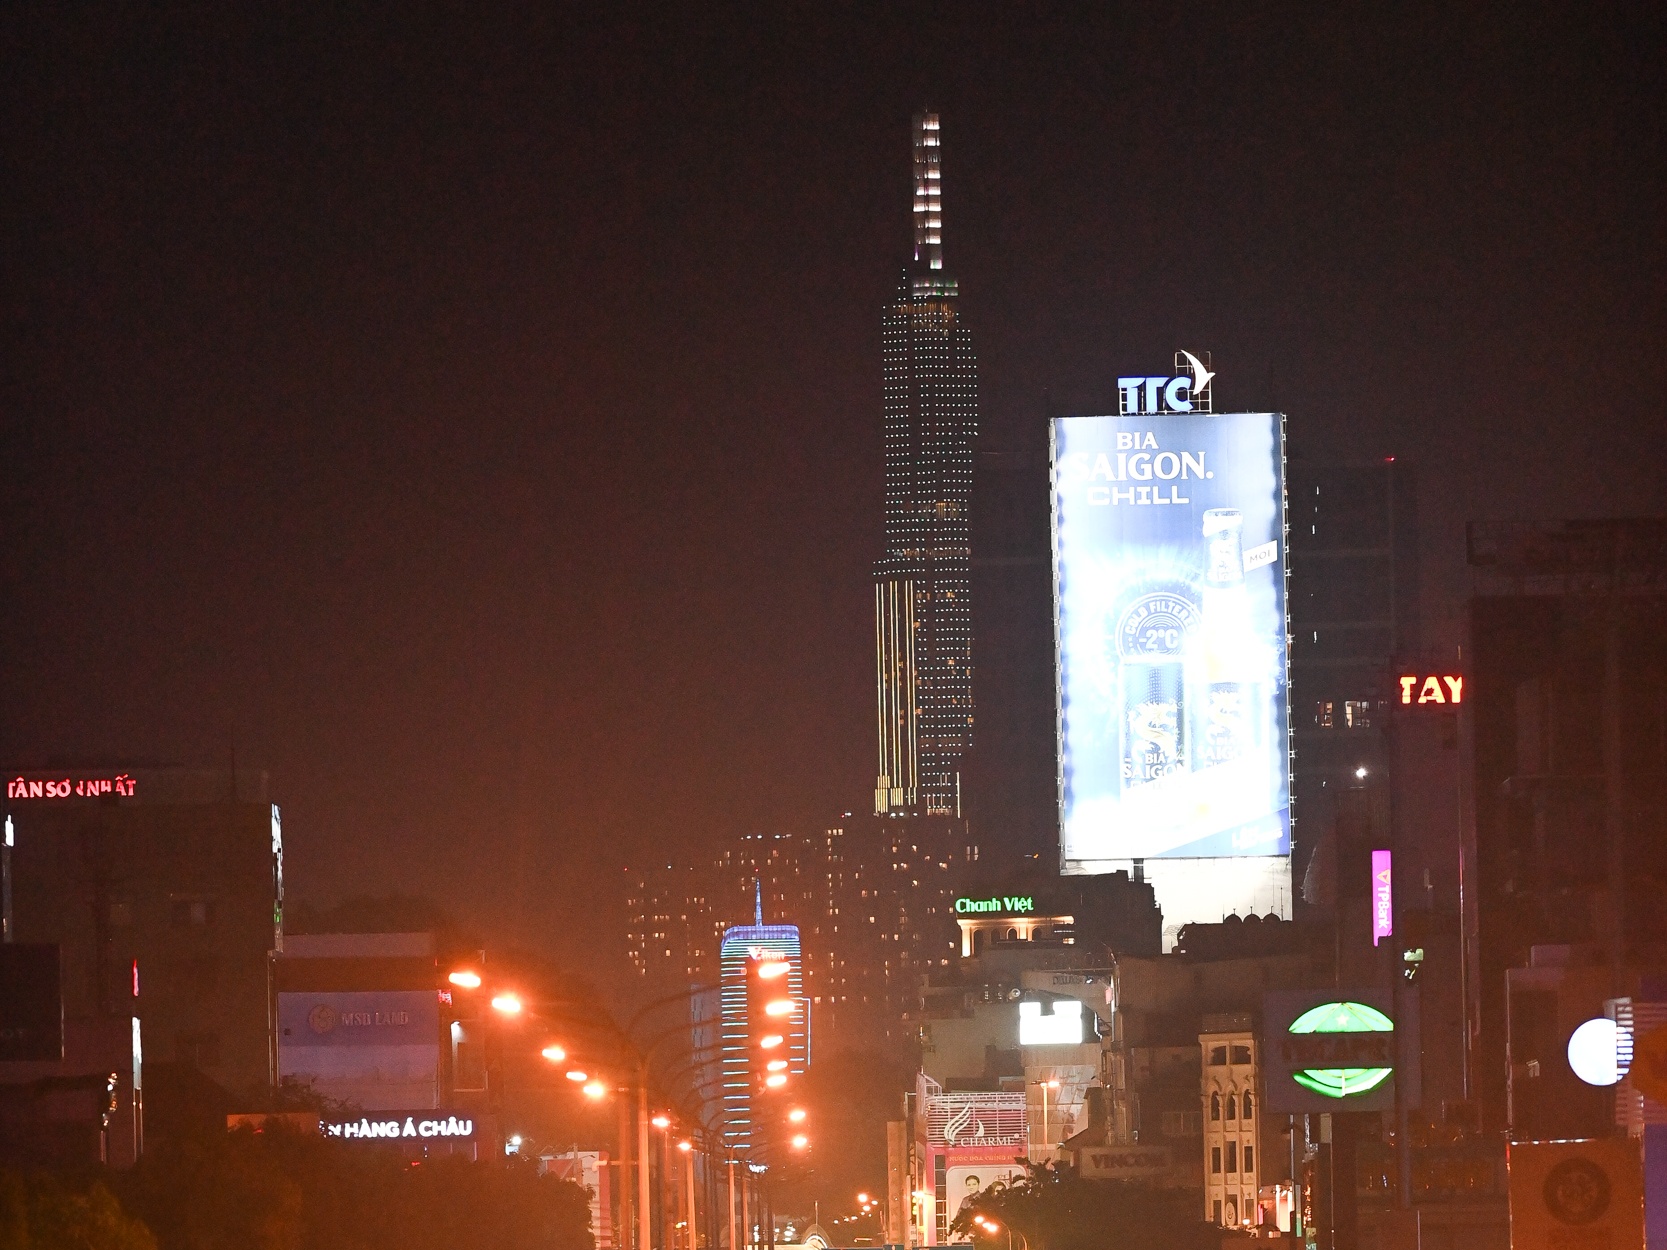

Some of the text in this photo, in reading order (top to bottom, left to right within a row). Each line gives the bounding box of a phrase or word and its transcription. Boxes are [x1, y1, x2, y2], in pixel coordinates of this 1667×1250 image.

[1118, 376, 1193, 412] TTC
[1116, 431, 1159, 450] BIA
[1086, 485, 1190, 506] CHILL
[1125, 603, 1148, 635] COLD
[1145, 753, 1166, 765] BIA
[8, 776, 43, 798] TÂN
[955, 896, 1034, 914] Chanh Việt
[1377, 884, 1390, 929] TPBank
[345, 1118, 400, 1138] HÀNG
[402, 1116, 417, 1137] Á
[418, 1115, 473, 1137] CHÂU
[961, 1136, 1015, 1147] CHARME
